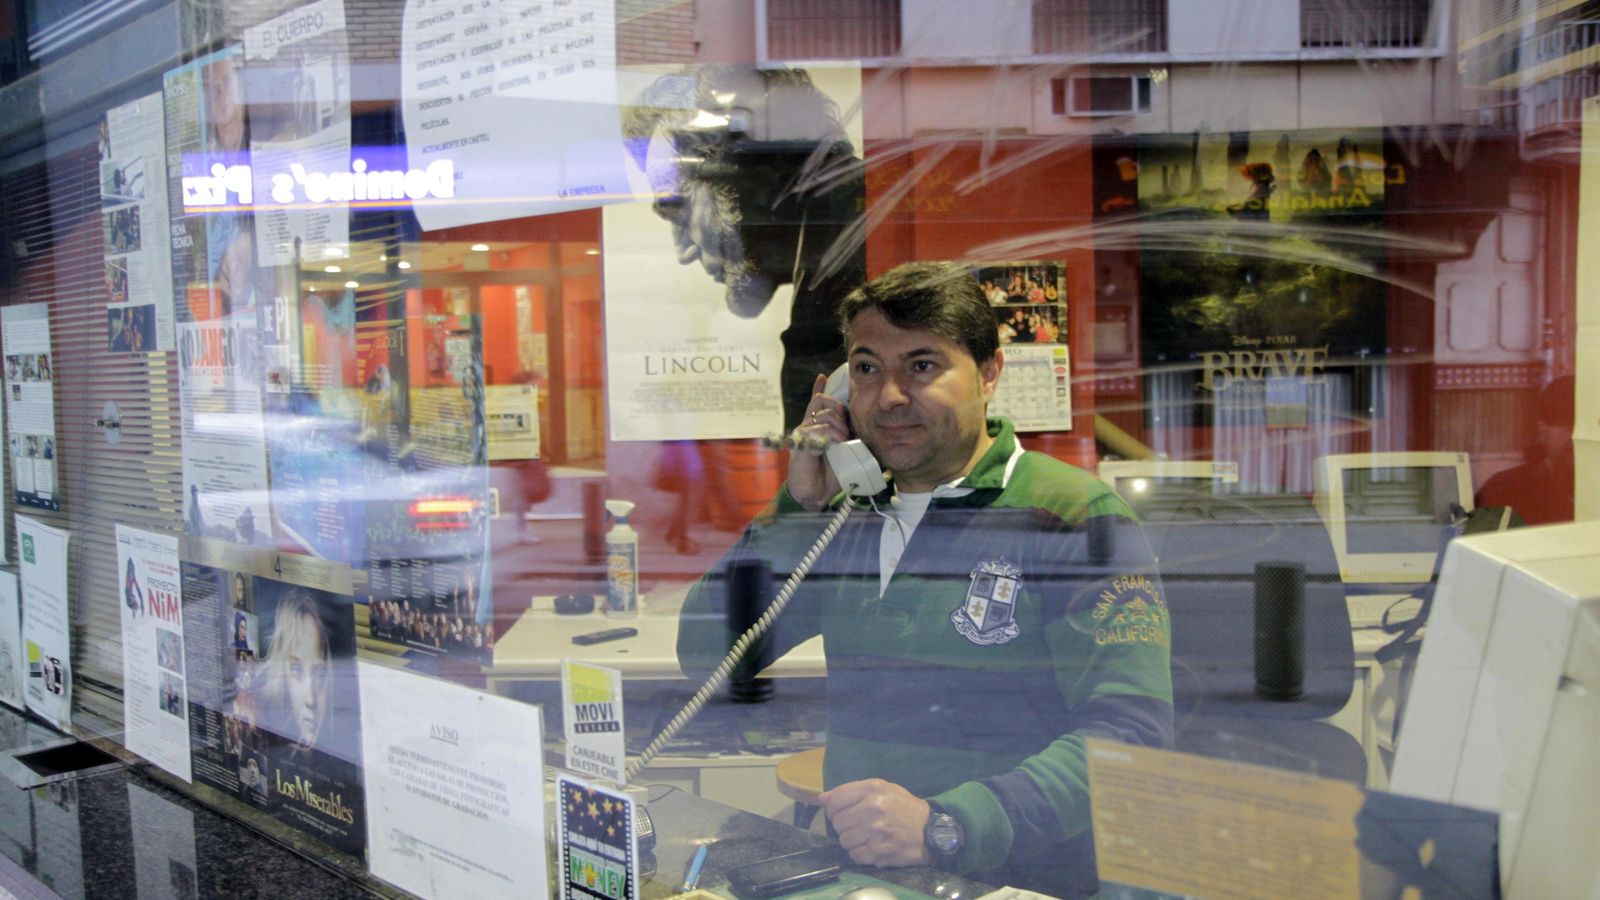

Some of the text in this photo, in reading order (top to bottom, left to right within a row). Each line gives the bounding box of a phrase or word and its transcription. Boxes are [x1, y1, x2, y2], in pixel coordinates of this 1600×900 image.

[263, 12, 323, 48] EL CUERPO
[570, 184, 606, 197] EMPRESA
[644, 353, 760, 376] LINCOLN
[1196, 345, 1329, 390] BRAVE
[147, 577, 179, 592] PROYECTO
[1093, 591, 1117, 617] SAN
[575, 703, 614, 722] MOVI
[430, 724, 459, 743] AVISO
[572, 745, 616, 767] CANJEABLE
[582, 761, 600, 774] ESTE
[601, 766, 619, 780] CINE
[275, 768, 295, 798] Los
[294, 774, 354, 825] Miserables
